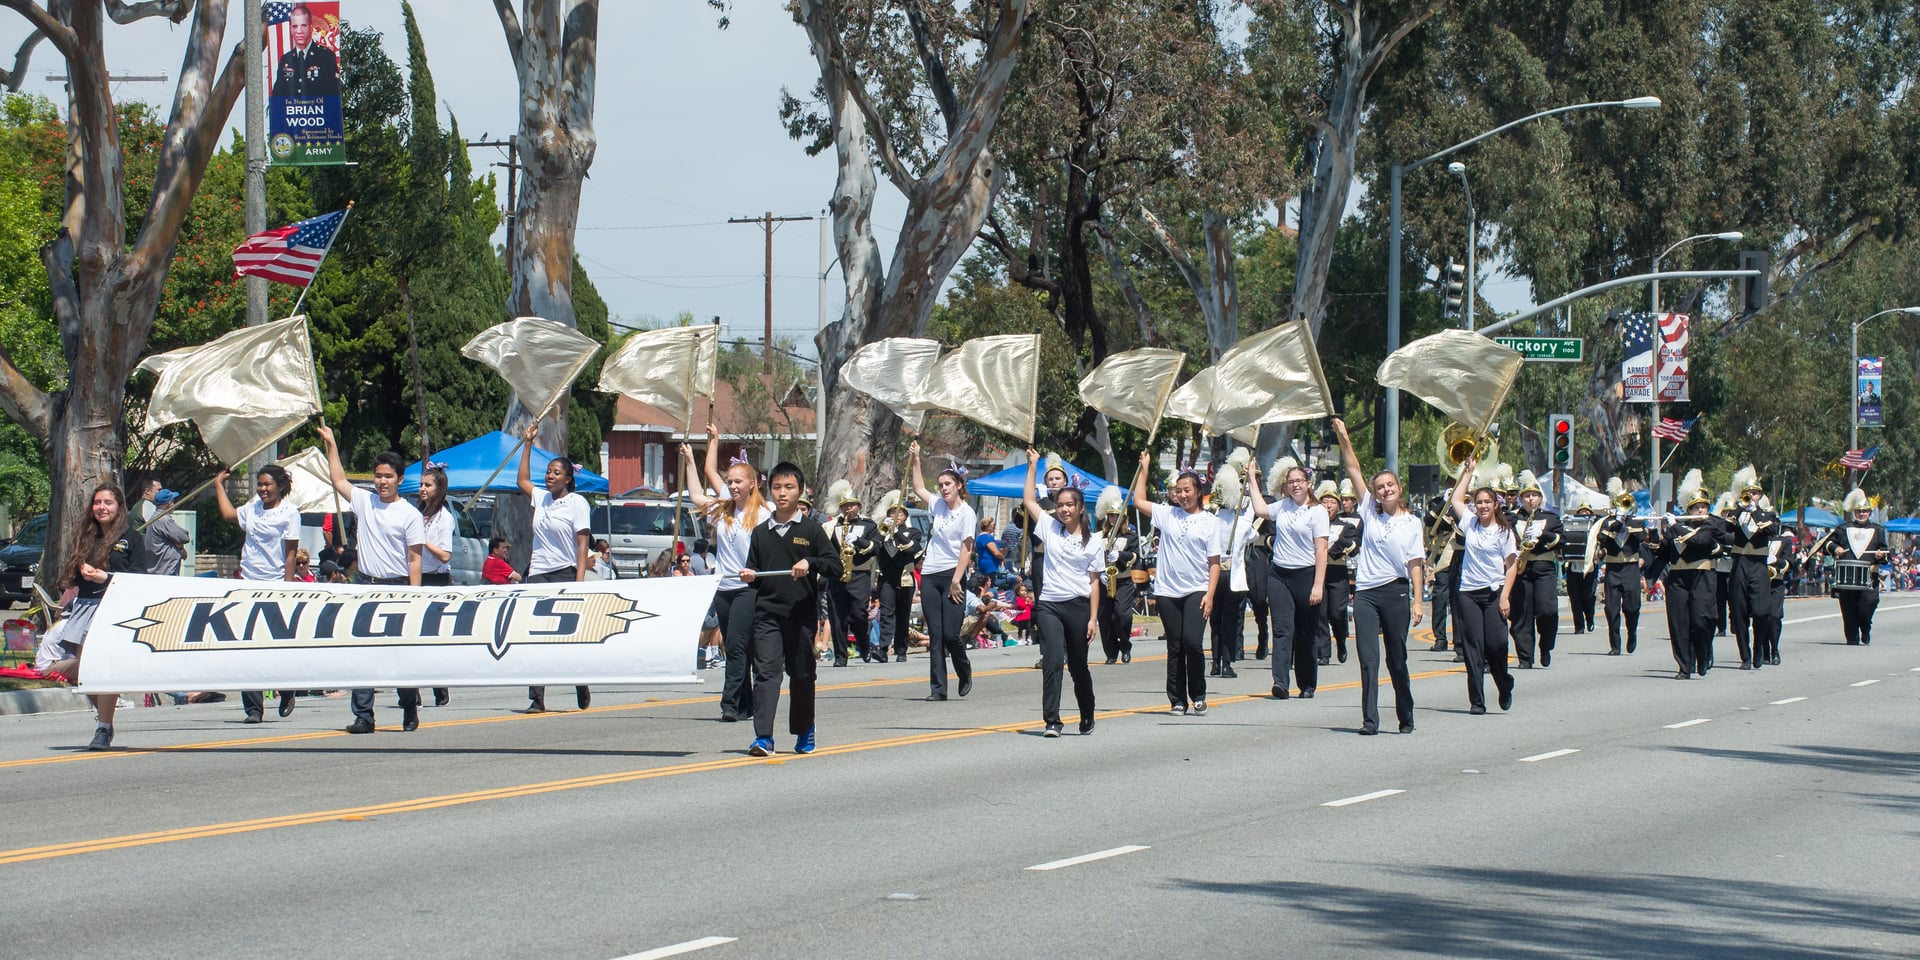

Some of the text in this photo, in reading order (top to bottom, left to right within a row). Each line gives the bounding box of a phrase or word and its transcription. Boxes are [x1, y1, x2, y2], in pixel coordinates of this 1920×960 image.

[286, 105, 324, 115] BRIAN
[286, 117, 325, 127] WOOD
[1502, 340, 1558, 354] Hickory
[1626, 366, 1649, 375] ARMED
[1626, 377, 1650, 386] FORCES
[1626, 388, 1650, 396] PARADE
[183, 595, 585, 650] KNIGHTS
